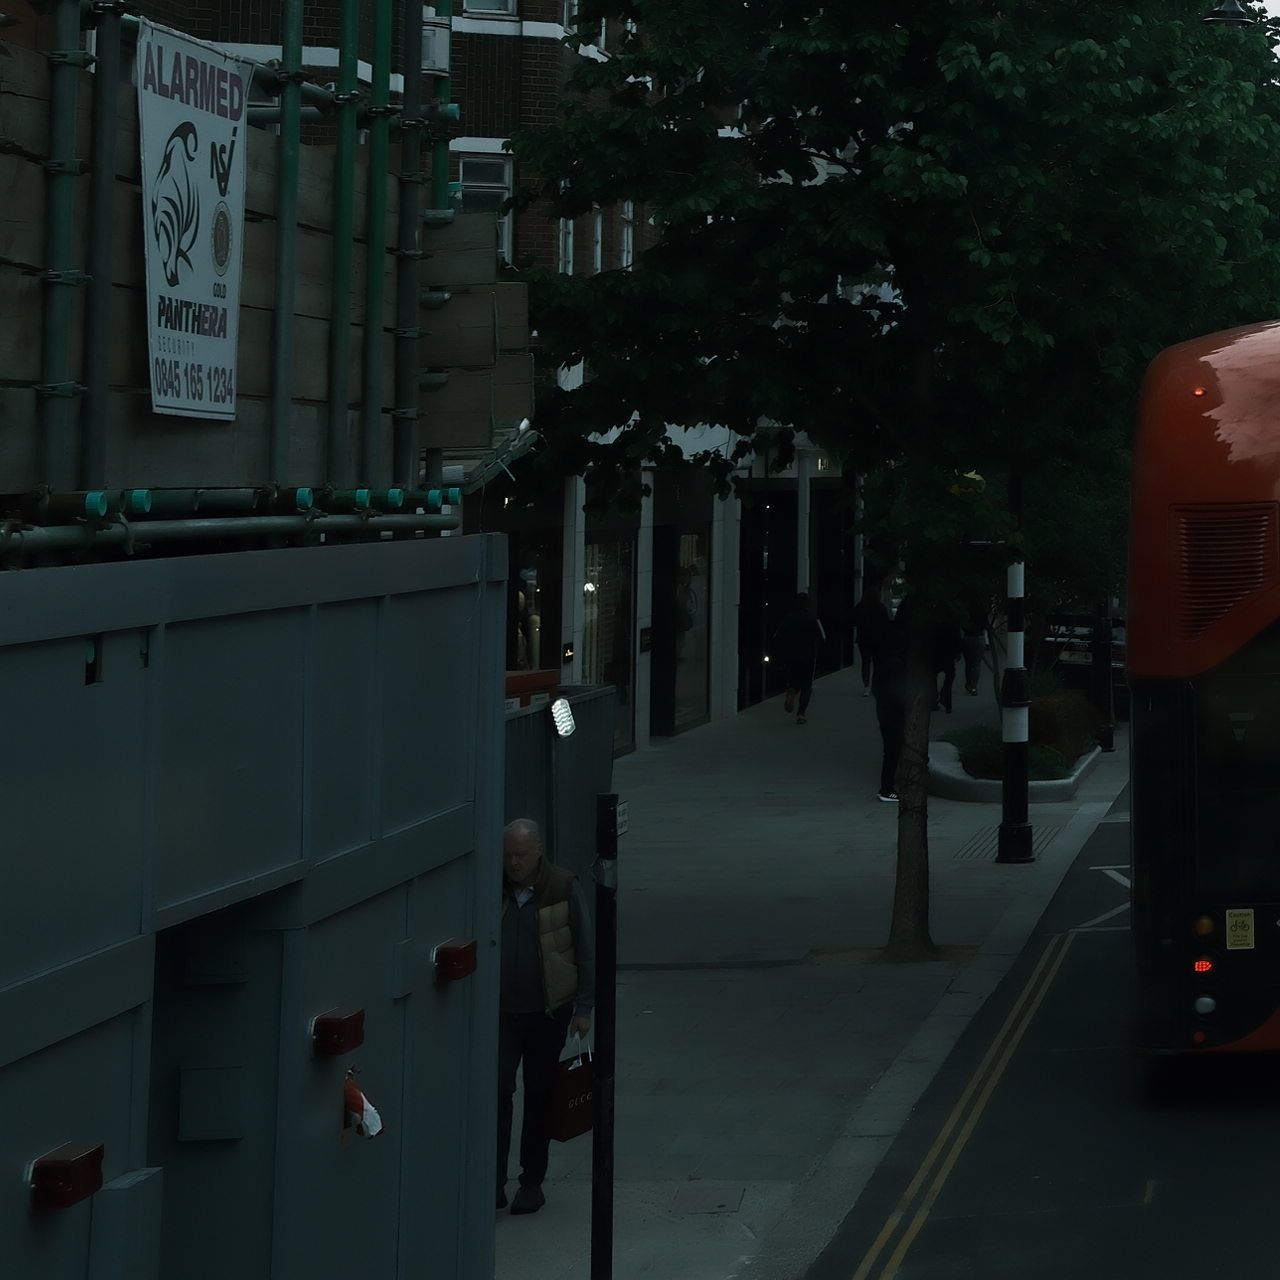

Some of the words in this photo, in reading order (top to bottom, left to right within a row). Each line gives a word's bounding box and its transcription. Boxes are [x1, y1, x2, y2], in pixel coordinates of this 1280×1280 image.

[143, 41, 244, 122] ALARMED
[213, 282, 227, 299] GOLD
[158, 295, 228, 339] PANTHERA
[158, 335, 196, 357] SECURITY
[155, 356, 181, 399] 0845
[184, 362, 203, 401] 165
[207, 366, 234, 404] 1234
